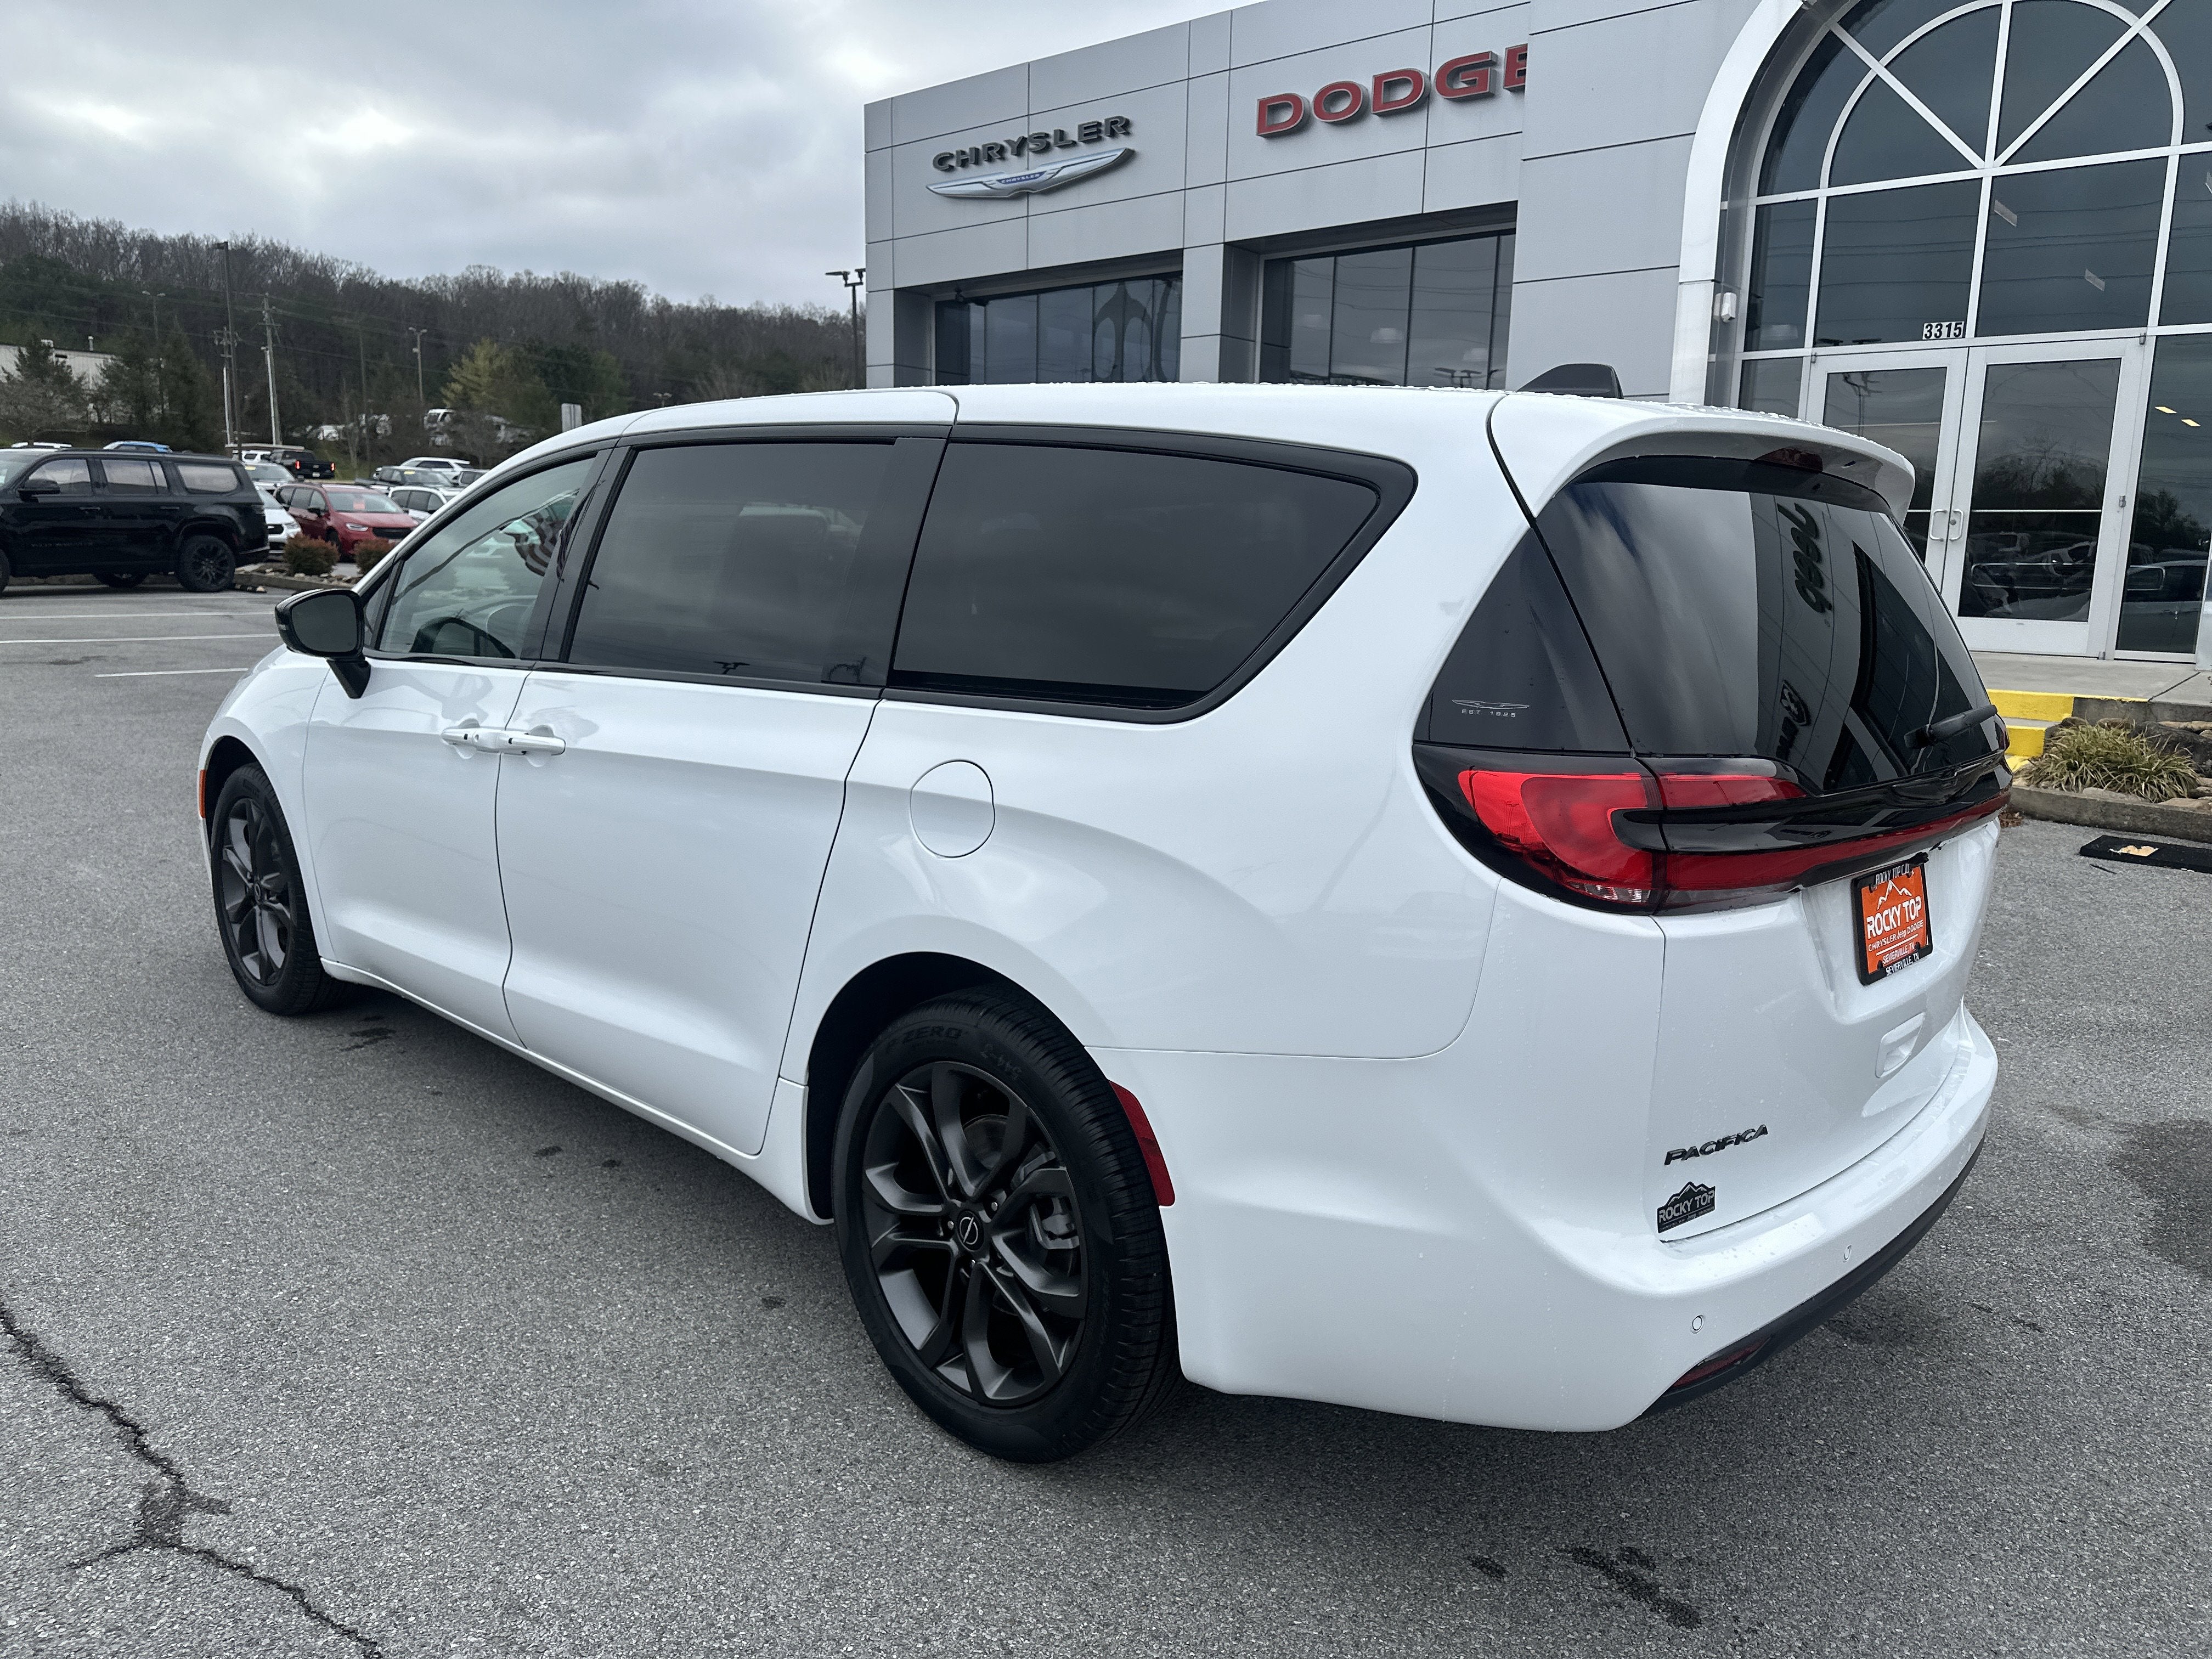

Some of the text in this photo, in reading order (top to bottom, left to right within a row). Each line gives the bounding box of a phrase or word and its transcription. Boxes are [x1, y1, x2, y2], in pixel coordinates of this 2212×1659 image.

[932, 115, 1132, 172] CHRYSLER
[1924, 323, 1962, 339] 3315
[1875, 870, 1892, 885] ROCKY
[1892, 865, 1901, 879] TOP
[1866, 896, 1922, 939] ROCKY TOP
[1868, 919, 1923, 952] CHRYSLER Jeep DODGE
[1913, 952, 1920, 962] TN
[902, 1025, 963, 1044] ZERO
[1664, 1124, 1768, 1165] PACIFICA
[1658, 1198, 1694, 1224] ROCKY
[1695, 1190, 1715, 1207] TOP
